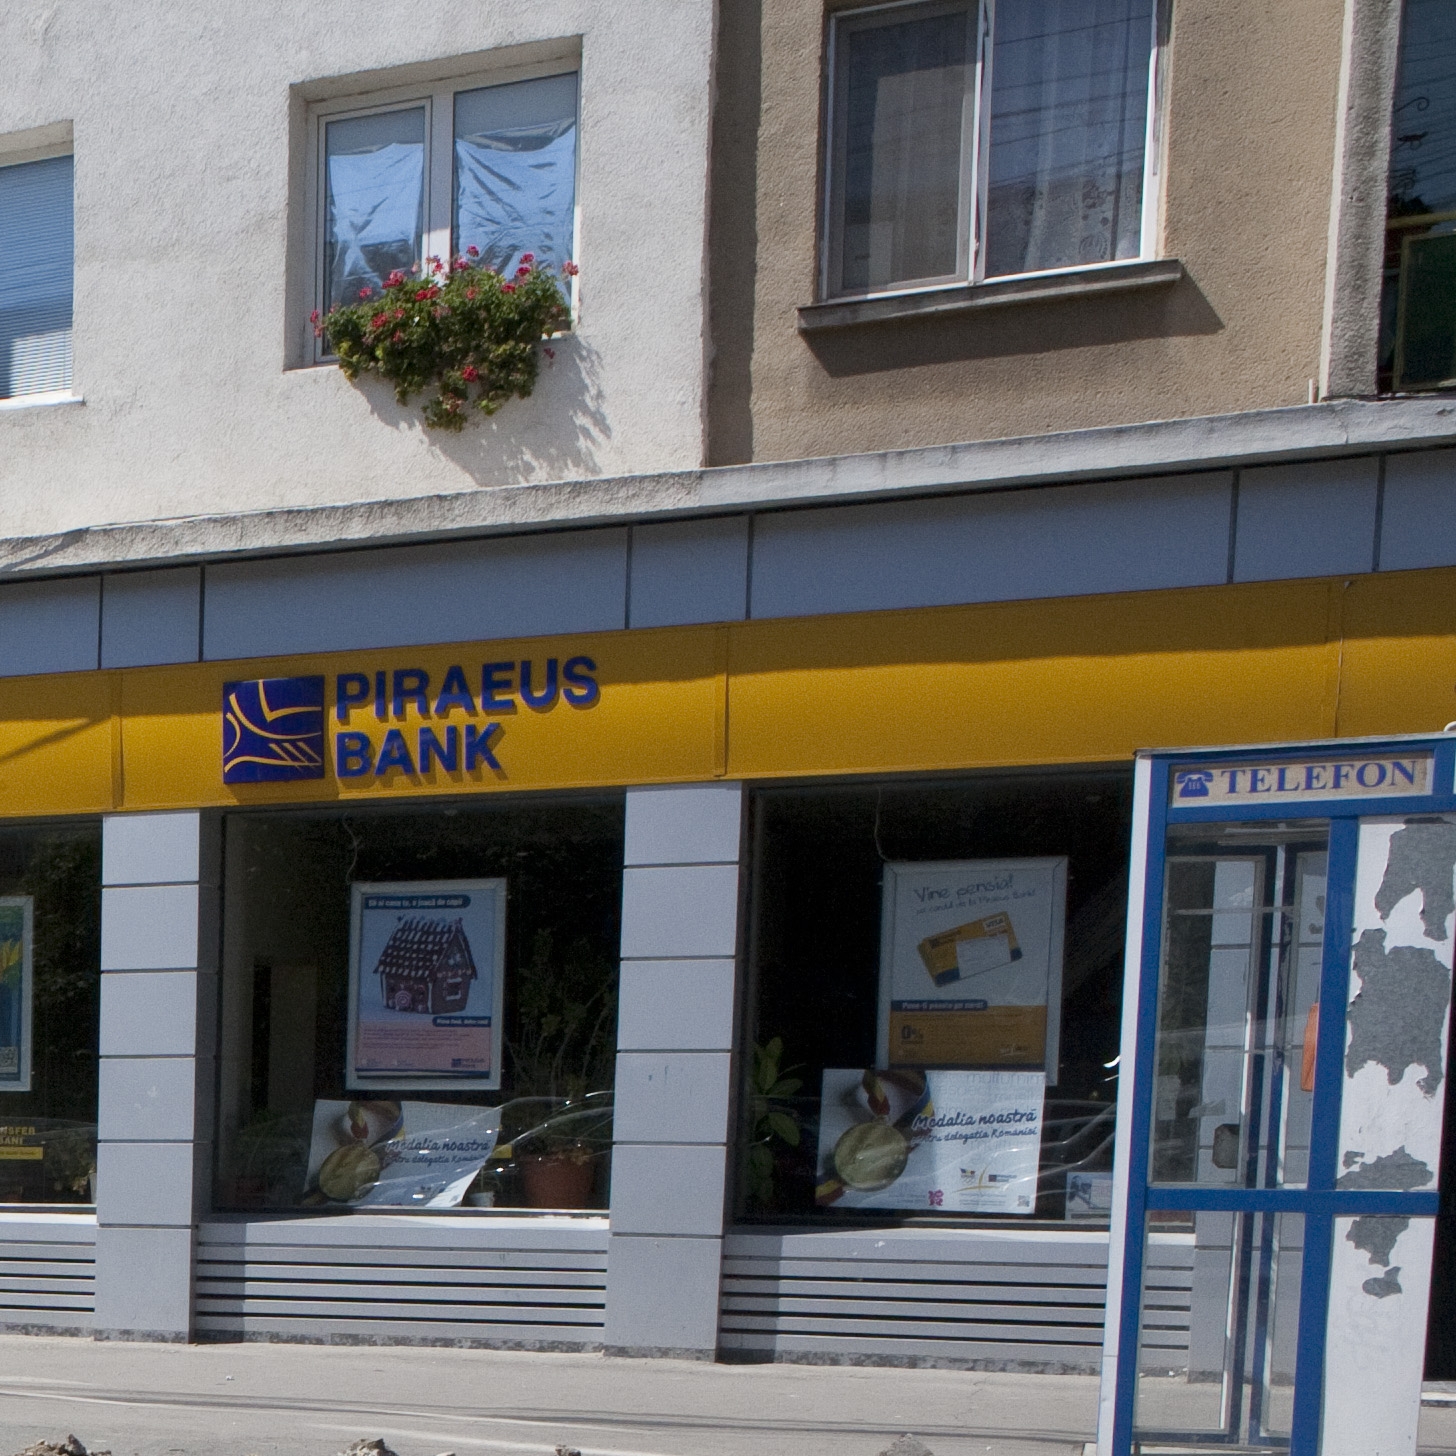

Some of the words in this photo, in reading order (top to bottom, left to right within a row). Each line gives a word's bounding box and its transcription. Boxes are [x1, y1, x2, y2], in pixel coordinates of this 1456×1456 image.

[336, 656, 600, 720] PIRAEUS
[336, 722, 501, 778] BANK
[1221, 760, 1417, 794] TELEFON
[912, 1112, 976, 1130] Medalia
[979, 1108, 1037, 1126] noastră
